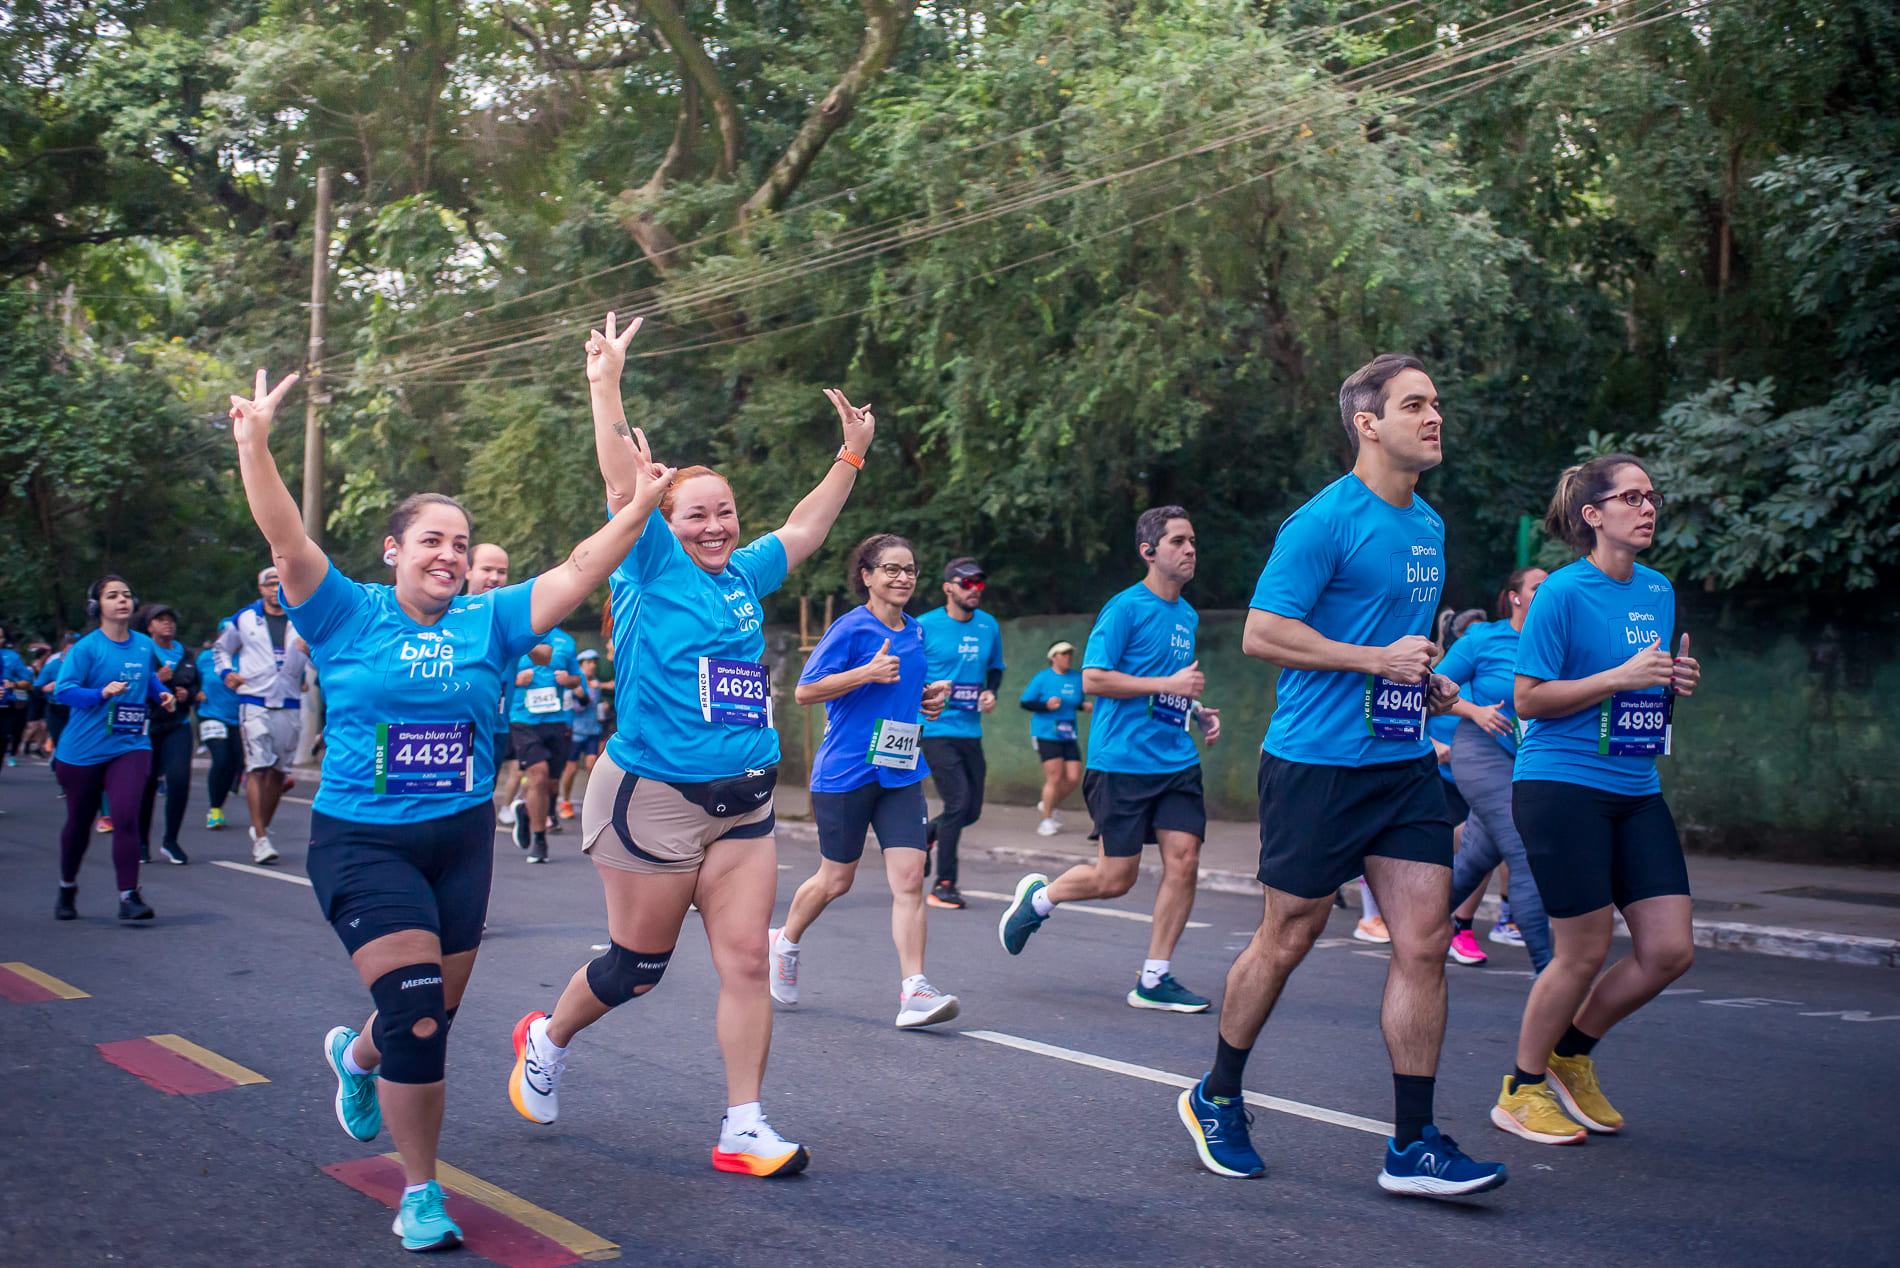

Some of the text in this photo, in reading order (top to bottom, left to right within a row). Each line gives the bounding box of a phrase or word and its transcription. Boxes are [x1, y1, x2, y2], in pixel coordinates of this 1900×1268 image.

[1419, 546, 1437, 556] Porto
[1407, 562, 1439, 582] blue
[1410, 586, 1437, 603] run
[733, 602, 754, 617] ue
[1634, 611, 1655, 620] Porto
[1625, 625, 1658, 644] blue
[400, 641, 454, 660] blue
[409, 661, 454, 678] run
[736, 666, 751, 677] blue
[751, 670, 761, 678] run
[716, 677, 764, 700] 4623
[1377, 689, 1422, 712] 4940
[1600, 711, 1609, 738] VERDE
[1617, 711, 1664, 730] 4939
[425, 730, 445, 740] blue
[446, 731, 462, 739] run
[884, 734, 914, 751] 2411
[376, 745, 384, 775] VERDE
[395, 742, 464, 765] 4432
